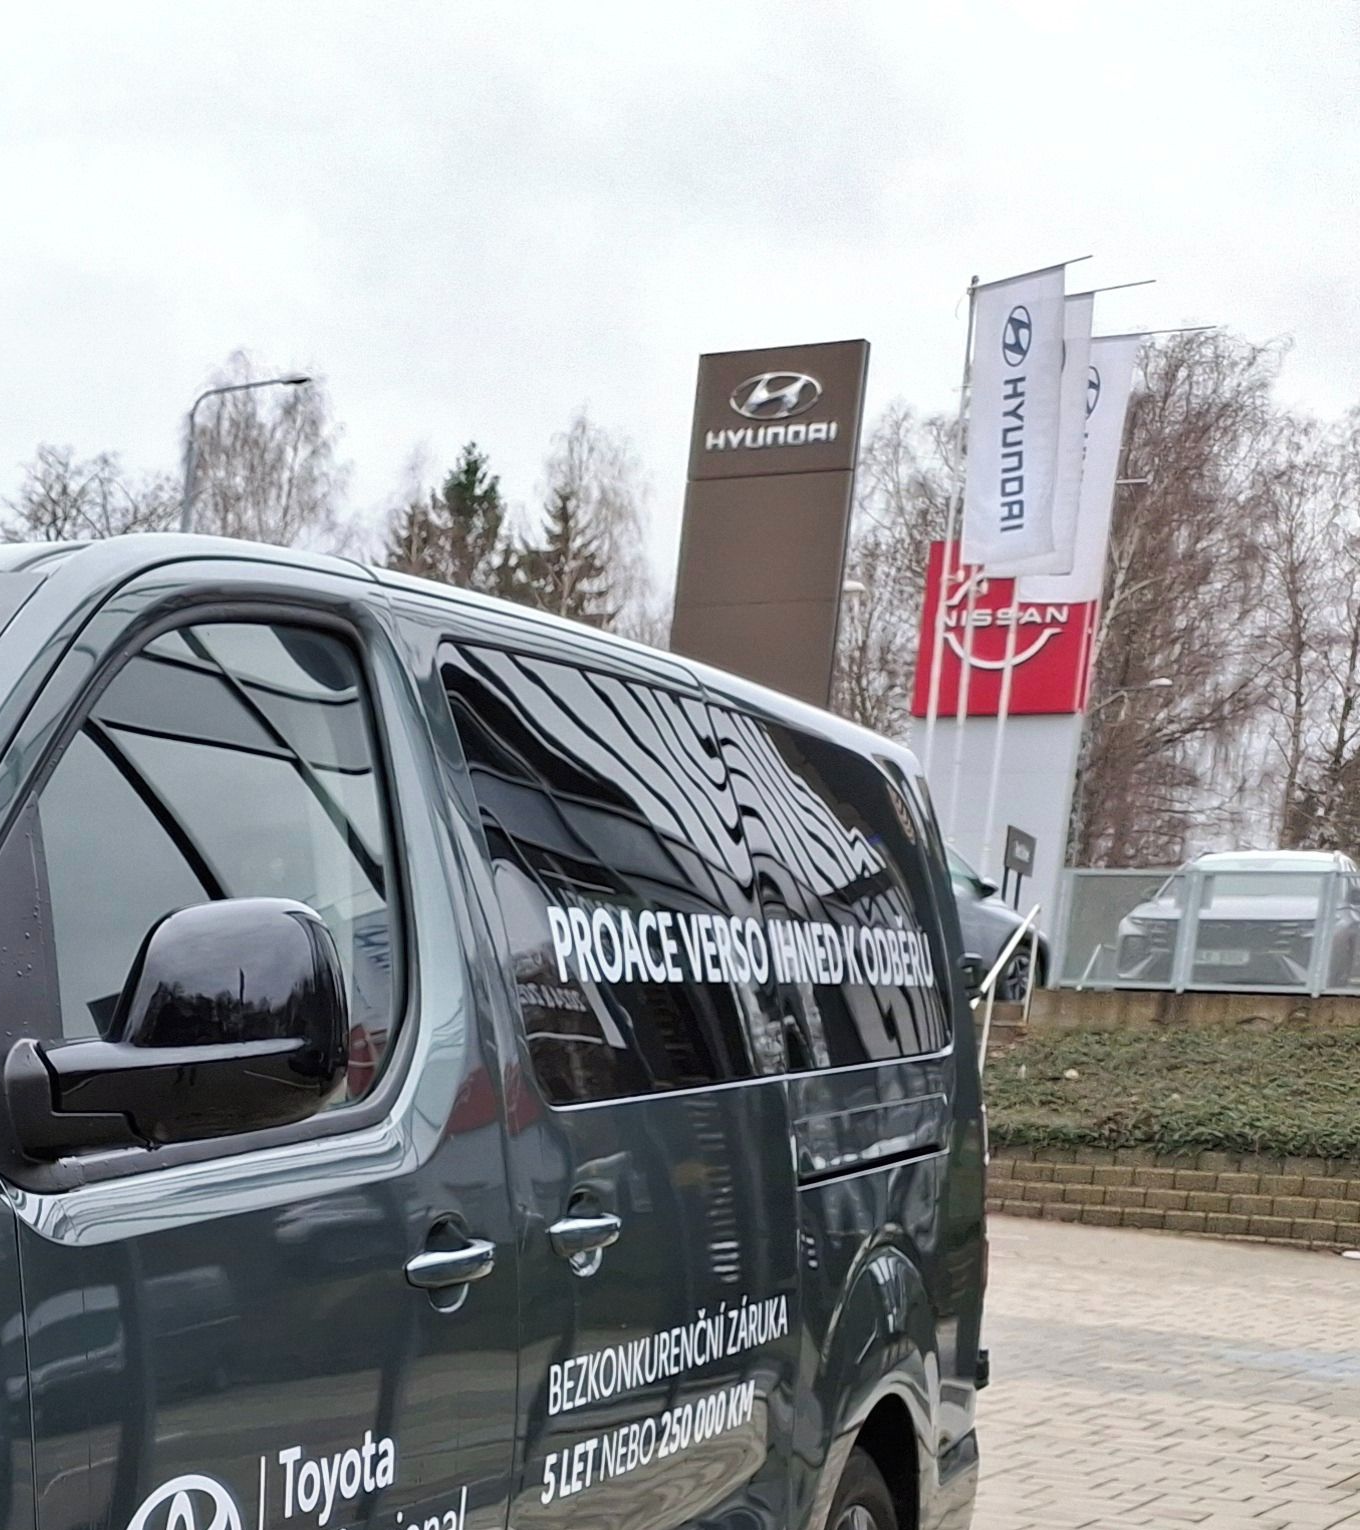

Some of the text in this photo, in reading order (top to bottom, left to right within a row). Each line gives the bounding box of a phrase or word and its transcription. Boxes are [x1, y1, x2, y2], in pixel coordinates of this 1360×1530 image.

[705, 421, 837, 452] HYUNDAI
[1000, 375, 1027, 534] HYUNDAI
[941, 605, 1069, 628] NISSAN
[546, 905, 936, 989] PROACE VERSO IHNED K ODBĚRU
[547, 1295, 789, 1417] BEZKONKURENČNÍ ZÁRUKA
[279, 1429, 396, 1527] Toyota
[540, 1379, 756, 1505] 5 LET NEBO 250 000 KM
